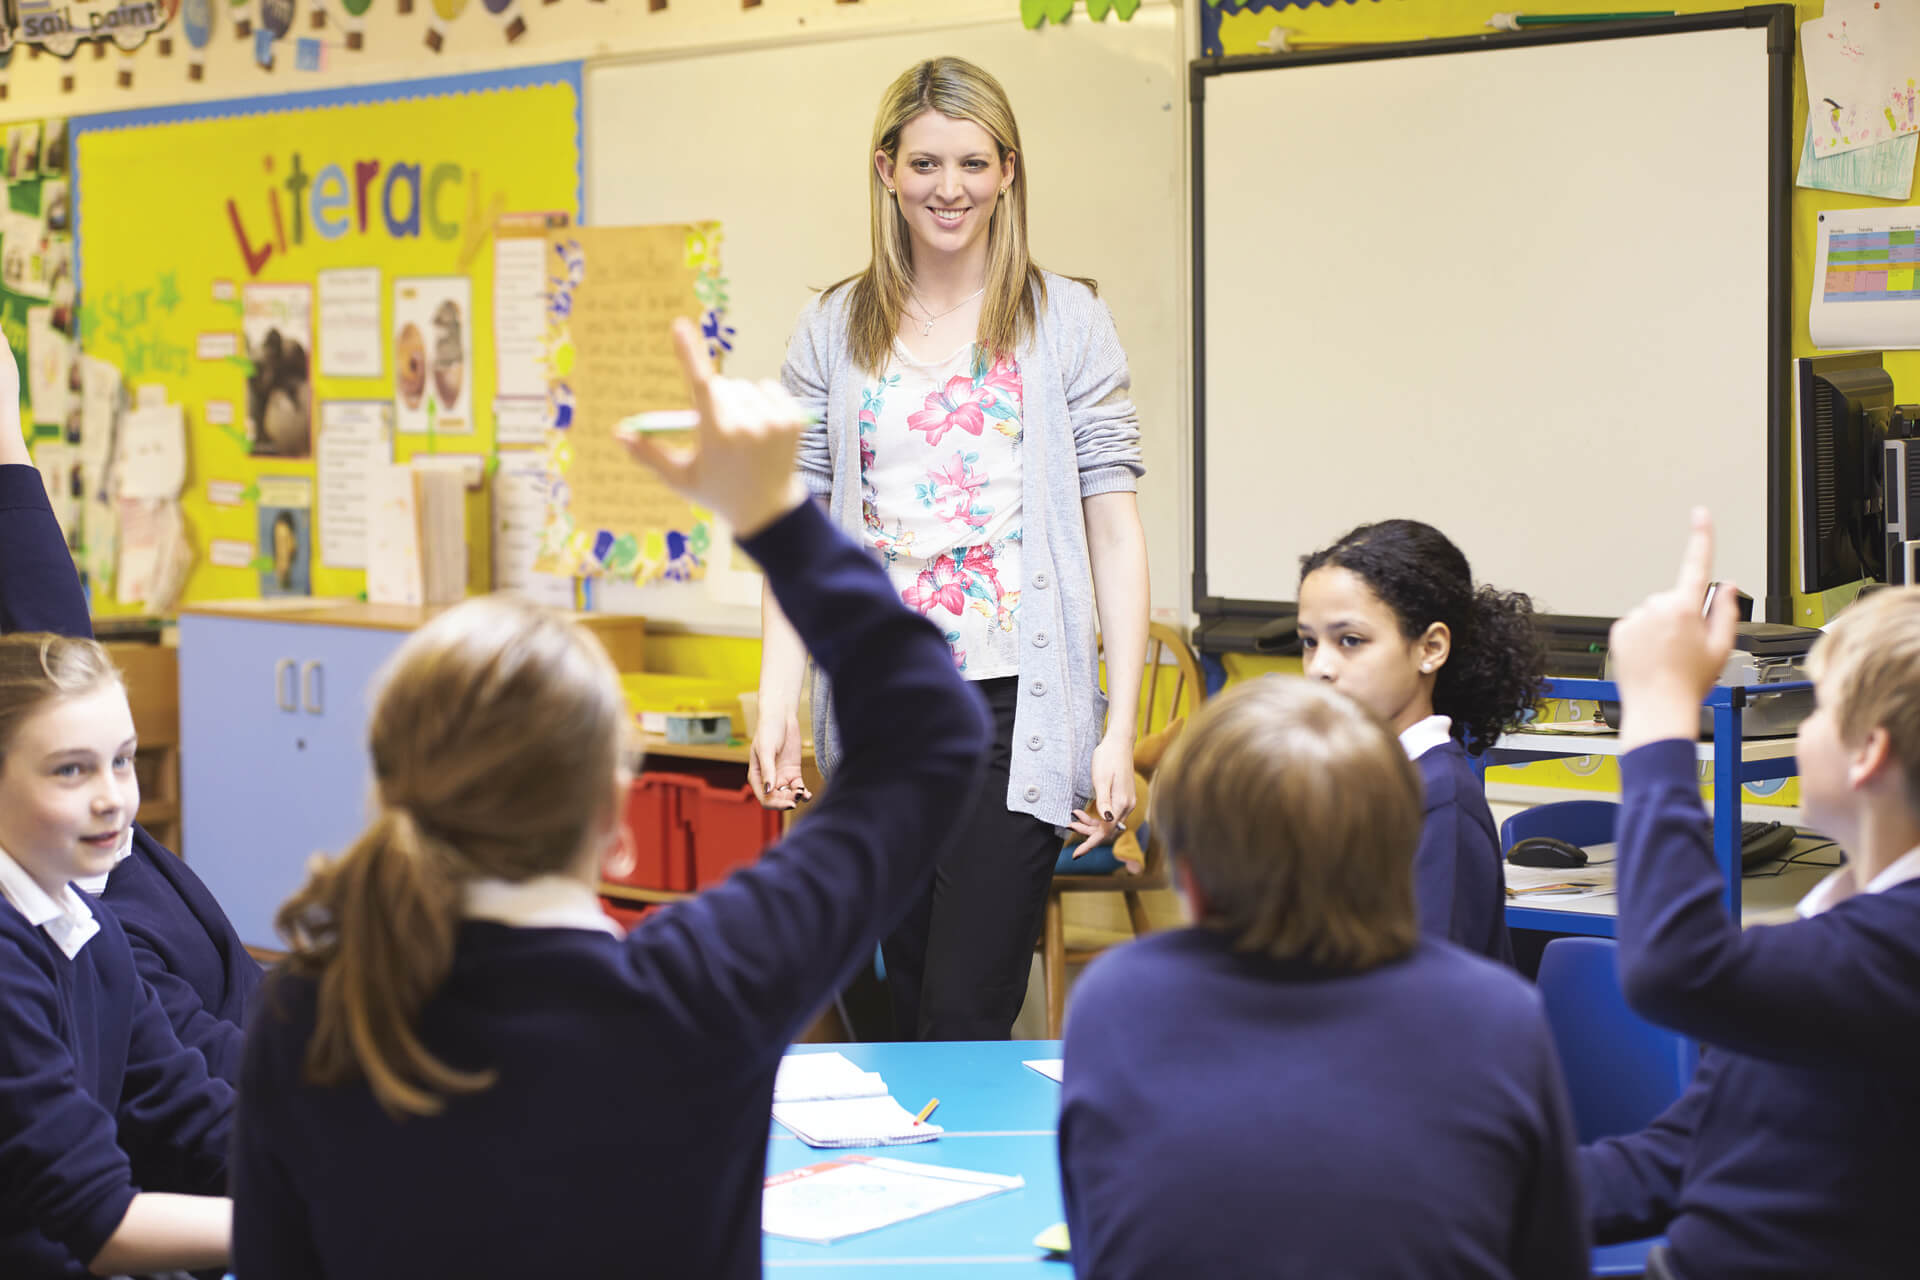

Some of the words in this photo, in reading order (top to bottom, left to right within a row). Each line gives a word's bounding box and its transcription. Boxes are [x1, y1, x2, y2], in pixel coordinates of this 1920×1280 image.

[25, 7, 72, 37] sail
[89, 2, 156, 35] paint
[225, 152, 507, 276] Literacy
